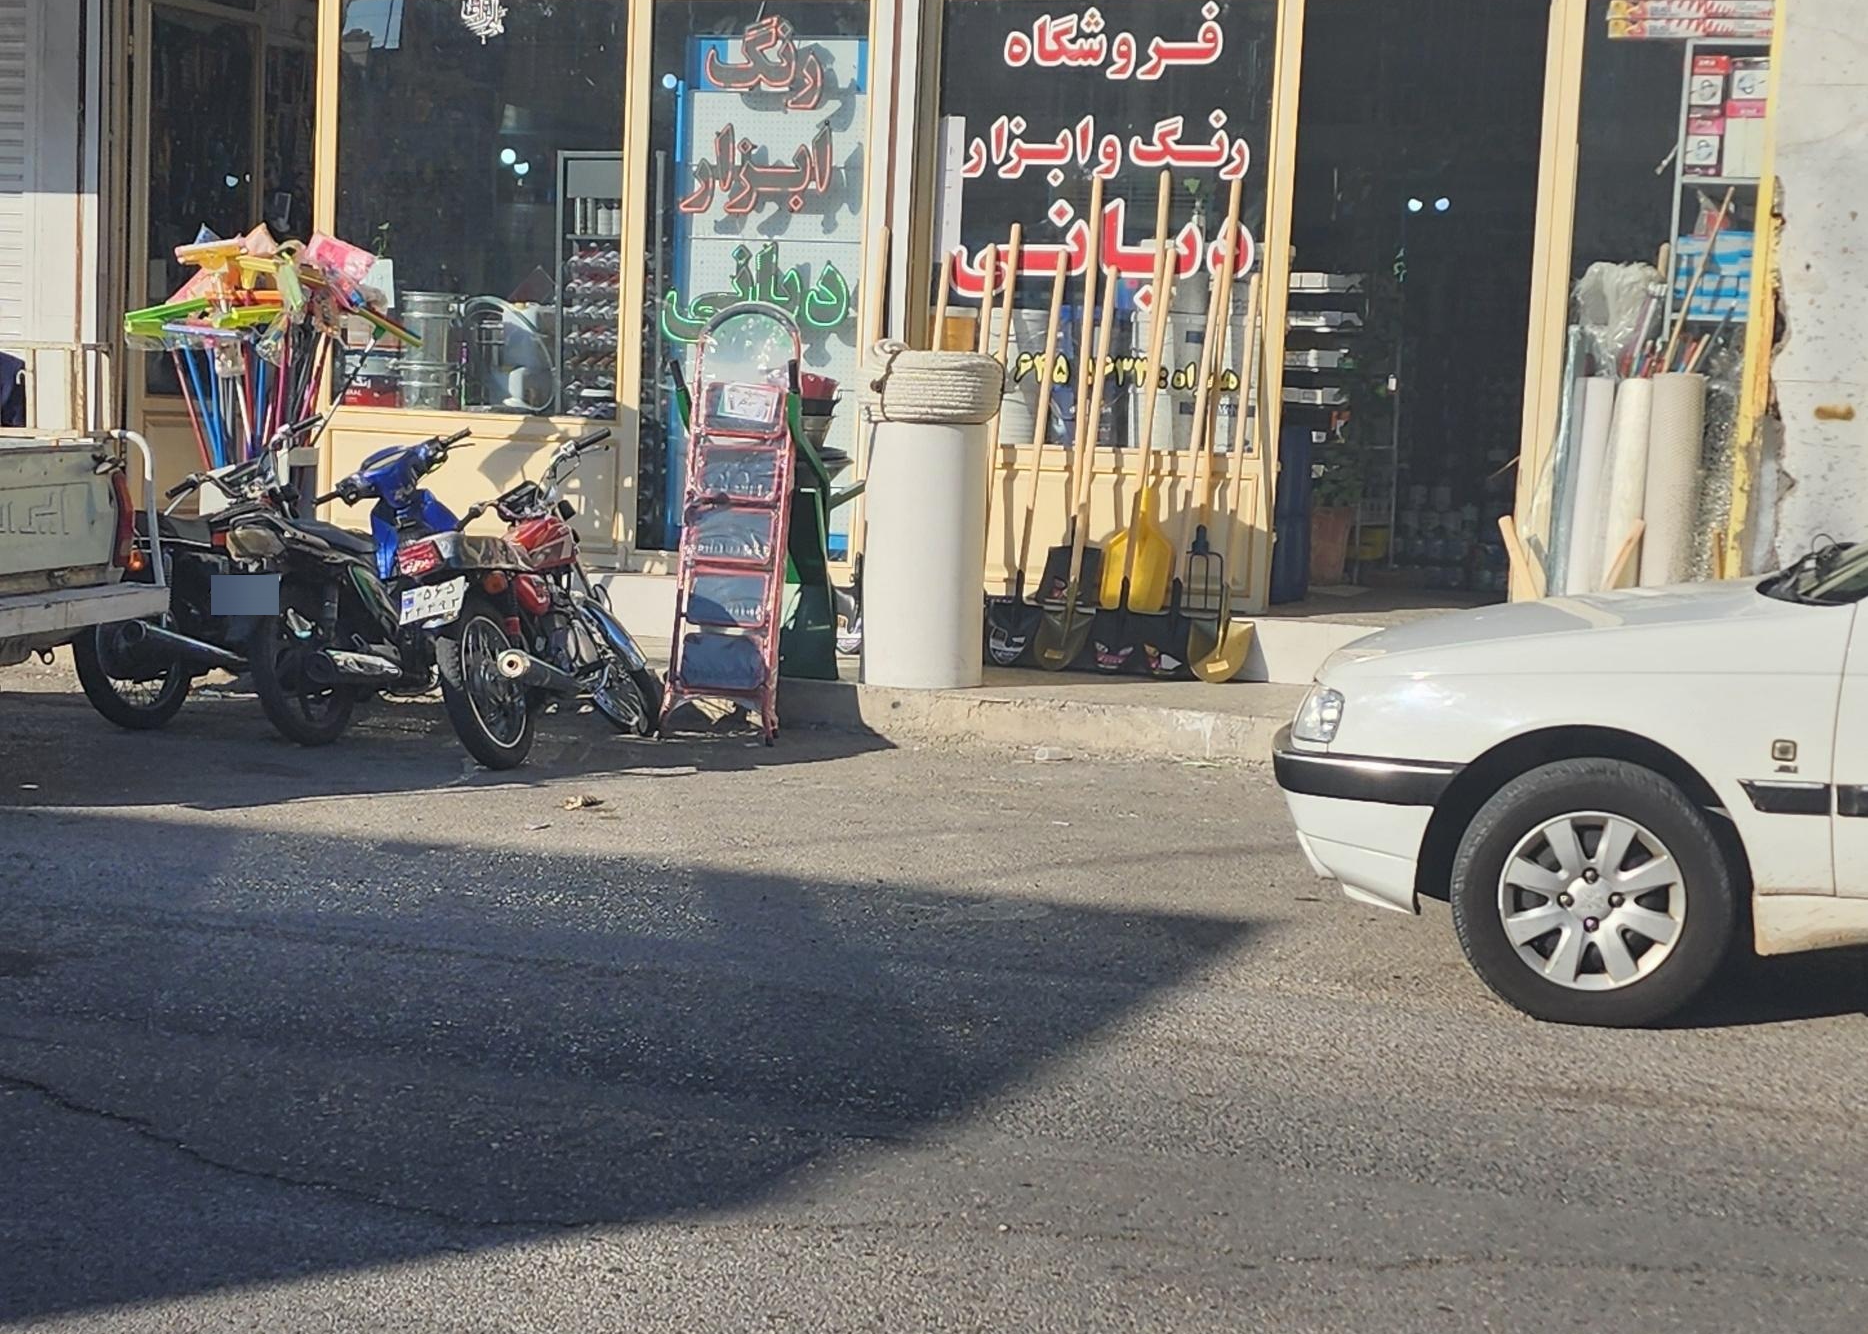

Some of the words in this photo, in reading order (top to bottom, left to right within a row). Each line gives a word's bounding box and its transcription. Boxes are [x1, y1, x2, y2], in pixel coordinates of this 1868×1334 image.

[705, 13, 823, 110] رنگ
[1003, 0, 1224, 80] فروشگاه
[679, 120, 833, 215] ابزار
[1128, 109, 1251, 182] رنگ
